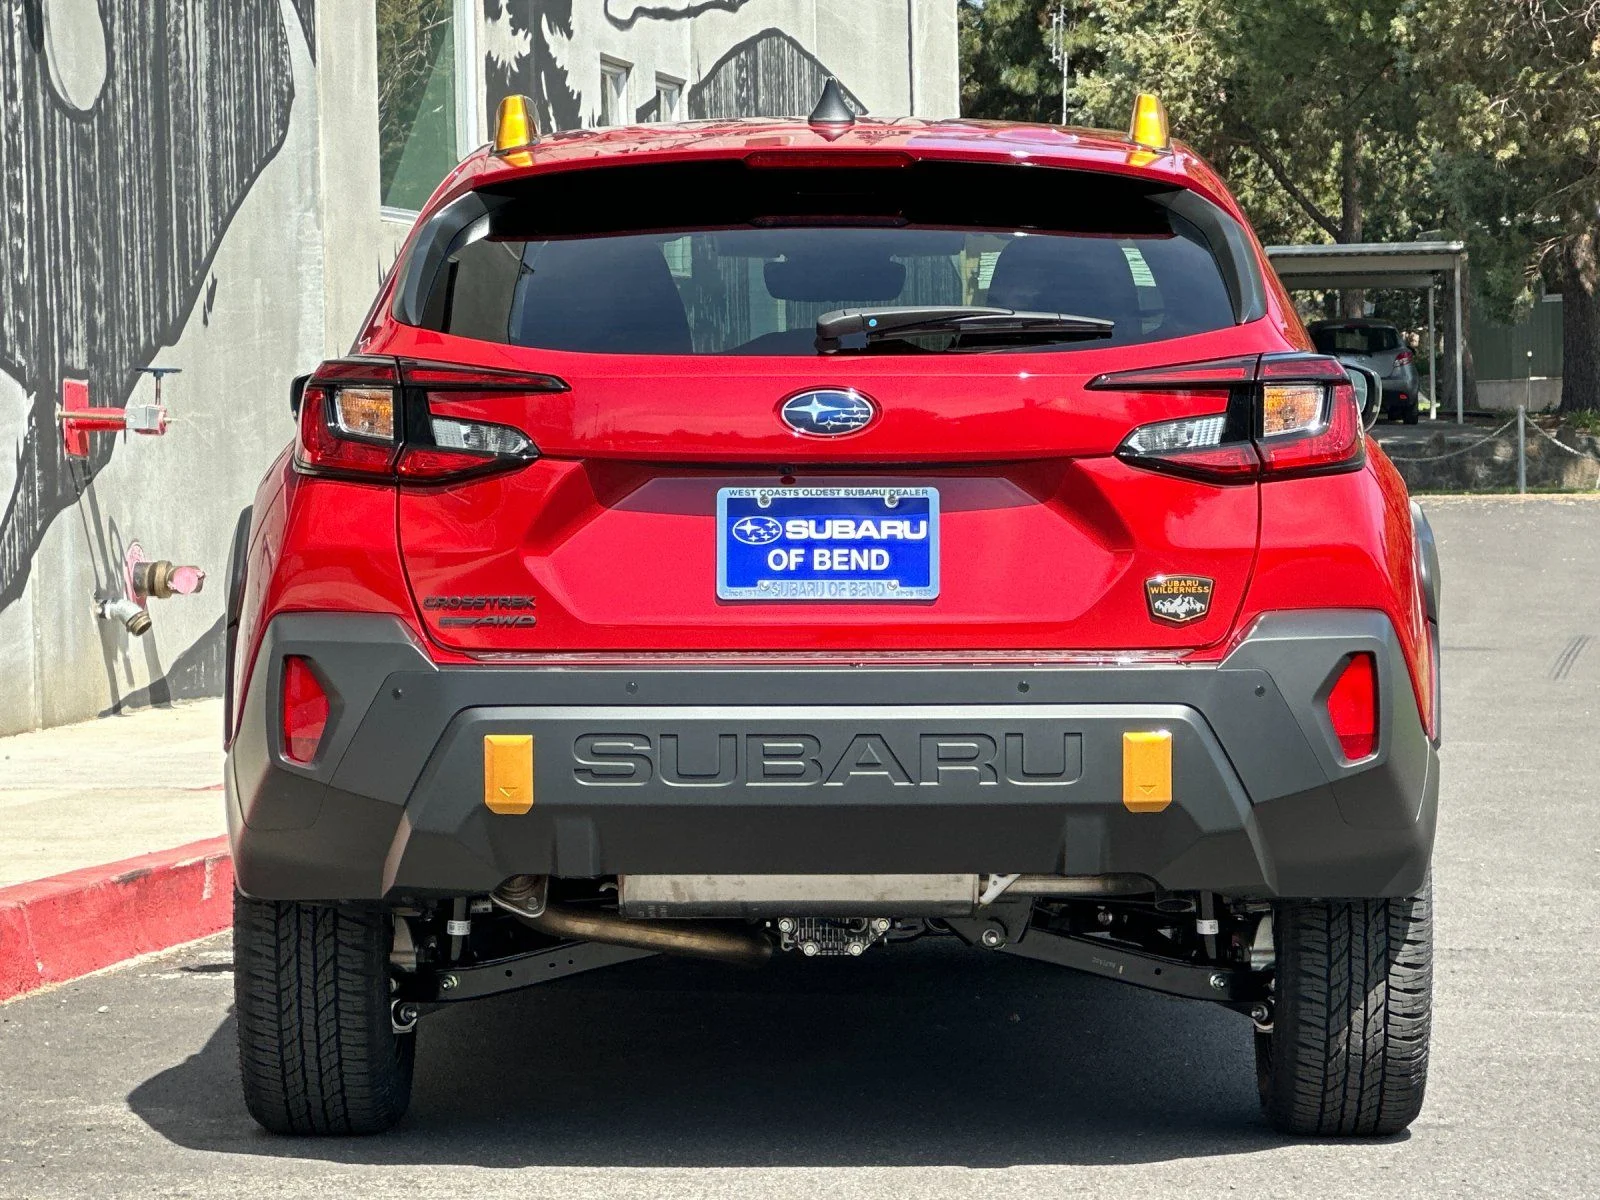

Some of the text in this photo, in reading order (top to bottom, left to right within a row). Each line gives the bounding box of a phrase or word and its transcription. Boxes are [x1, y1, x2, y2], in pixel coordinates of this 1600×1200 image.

[802, 488, 841, 496] OLDEST
[844, 488, 886, 496] SUBARU
[888, 488, 928, 496] DEALER
[785, 519, 928, 540] SUBARU
[767, 549, 890, 571] OF BEND
[771, 581, 885, 597] SUBARU OF BEND
[423, 596, 536, 610] CROSSTREK
[573, 732, 1083, 788] SUBARU
